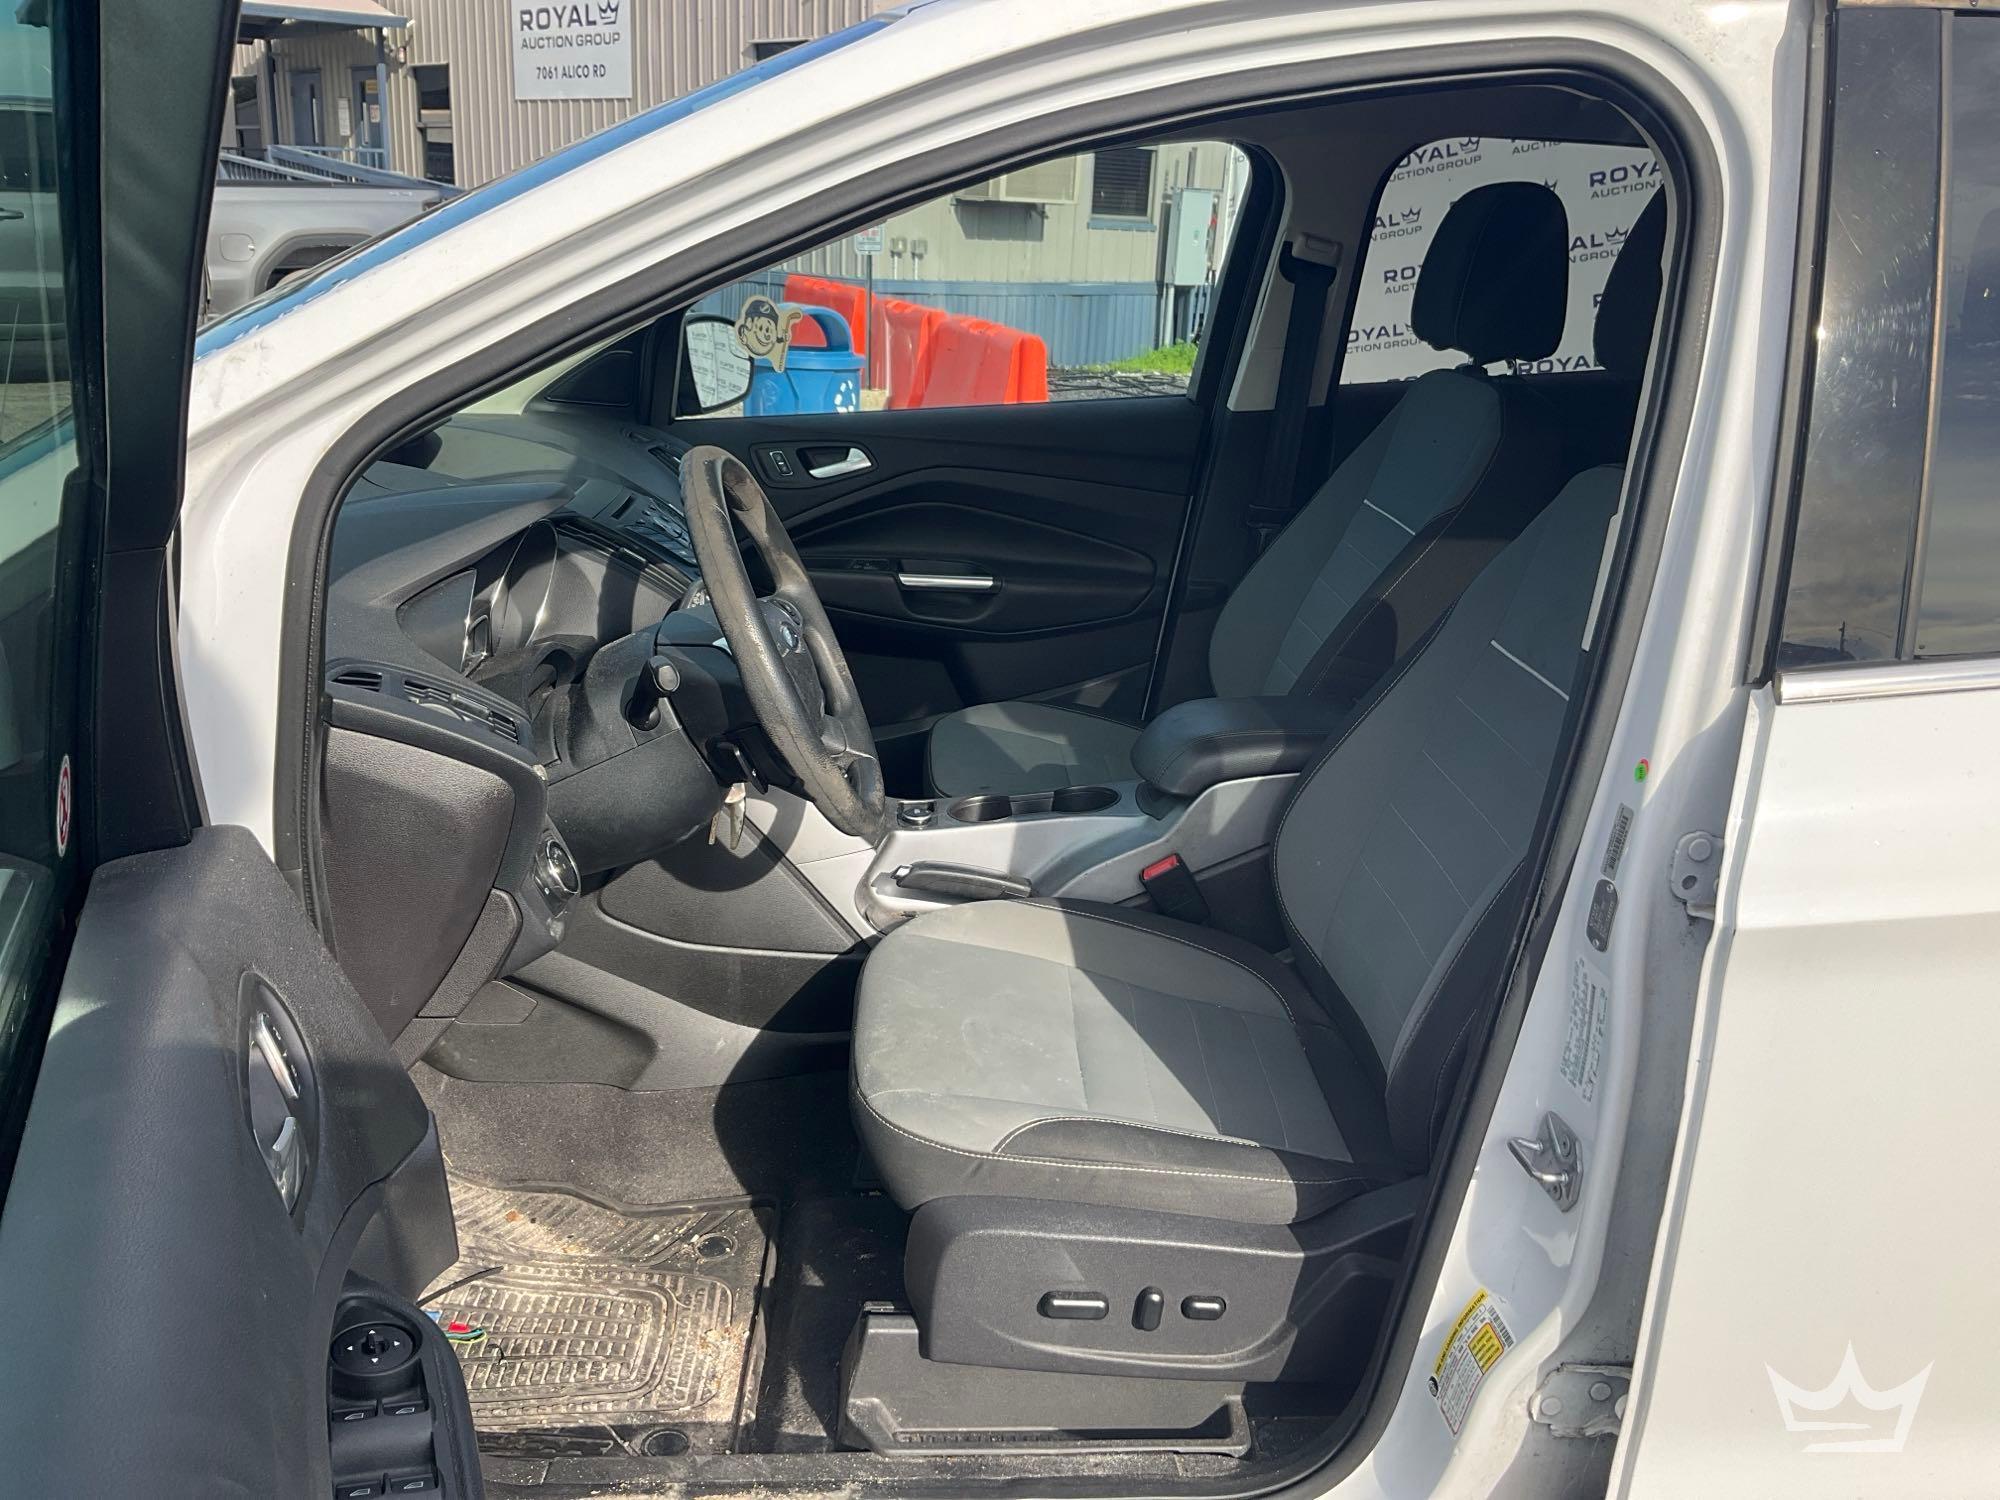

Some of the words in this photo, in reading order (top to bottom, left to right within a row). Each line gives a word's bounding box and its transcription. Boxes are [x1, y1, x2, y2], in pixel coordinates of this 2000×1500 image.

[520, 4, 597, 31] ROYAL
[521, 35, 573, 50] AUCTION
[575, 32, 620, 47] GROUP
[536, 66, 558, 80] 7061
[561, 64, 590, 79] ALICO
[593, 64, 606, 78] RD
[1398, 143, 1458, 168] OYAL
[1389, 165, 1434, 182] UCTION
[1436, 155, 1482, 172] GROUP
[1590, 161, 1661, 187] ROYA
[1591, 180, 1656, 199] AUCTION
[1380, 225, 1422, 241] GROUP
[1579, 249, 1620, 262] GROU
[1385, 282, 1416, 295] AUCT
[1348, 324, 1404, 343] OYAL
[1346, 344, 1381, 354] CTION
[1384, 338, 1421, 349] GROU
